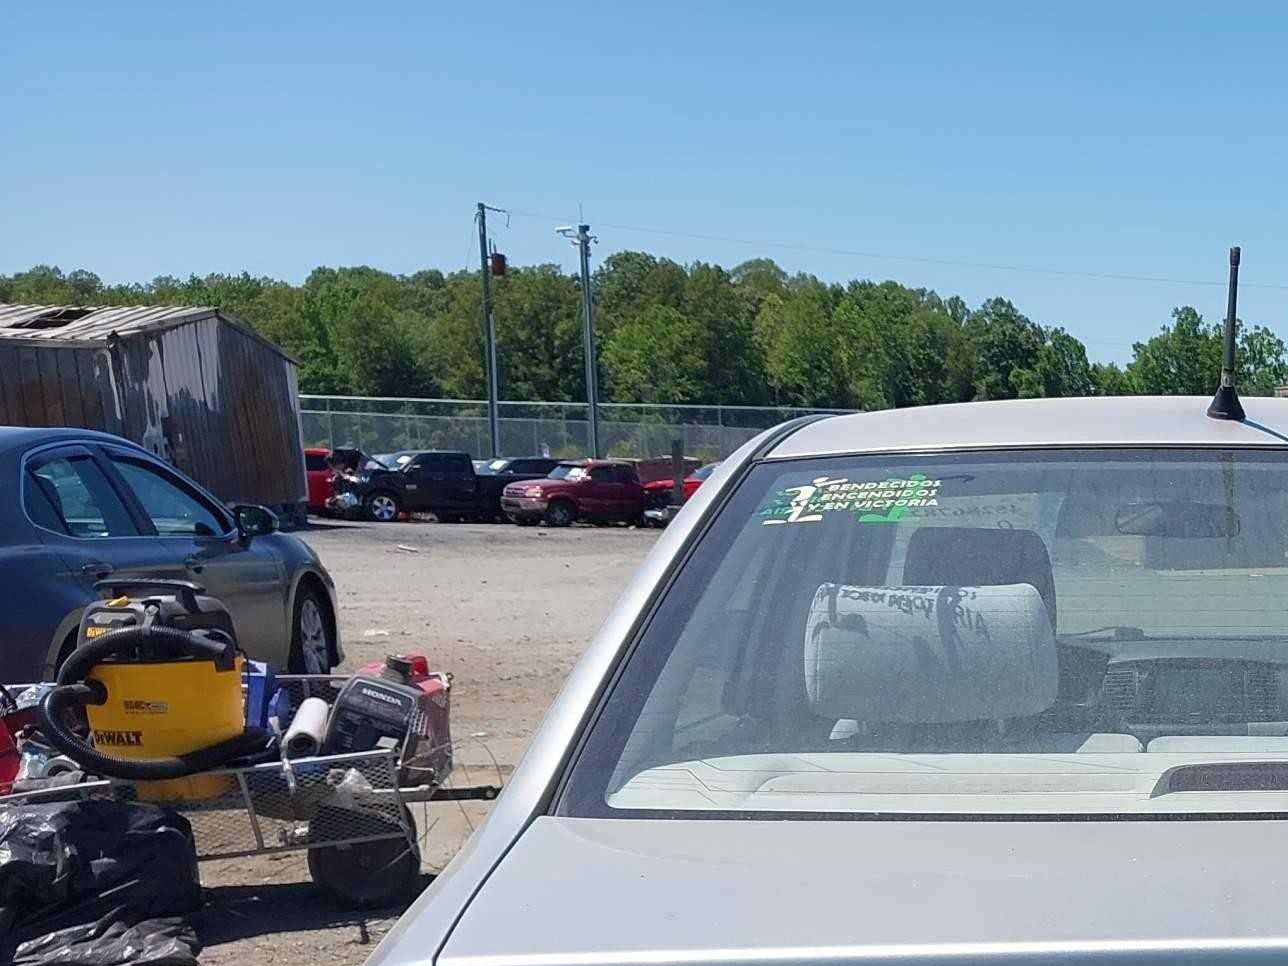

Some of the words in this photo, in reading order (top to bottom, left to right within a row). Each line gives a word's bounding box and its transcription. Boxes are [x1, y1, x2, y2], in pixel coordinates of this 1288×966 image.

[828, 480, 942, 491] BENDECIDOS
[821, 489, 938, 501] ENCENDIDOS
[823, 501, 850, 510] EN
[854, 499, 939, 509] VICTORIA
[361, 687, 403, 706] HONDA
